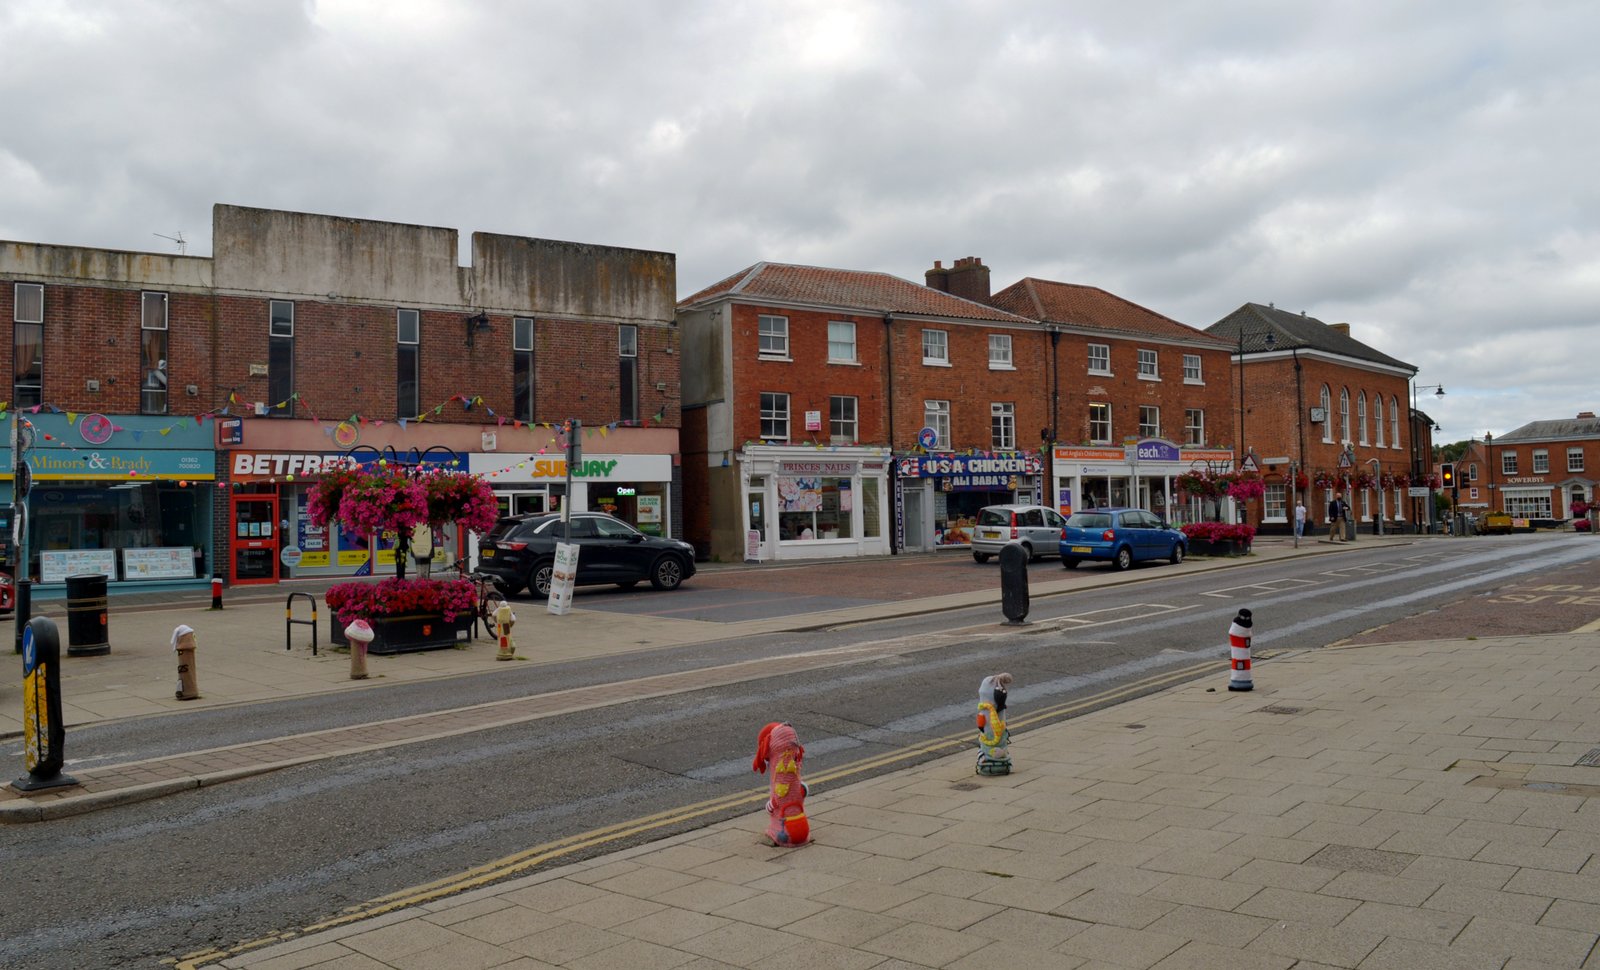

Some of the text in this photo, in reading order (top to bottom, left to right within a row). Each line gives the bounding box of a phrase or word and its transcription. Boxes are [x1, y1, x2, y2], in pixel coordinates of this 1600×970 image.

[32, 453, 150, 472] Minors & Brady
[783, 463, 850, 471] PRINCES NAILS
[968, 459, 1026, 473] CHICKEN
[953, 475, 1008, 486] ALI BABA'S
[617, 486, 635, 495] Open
